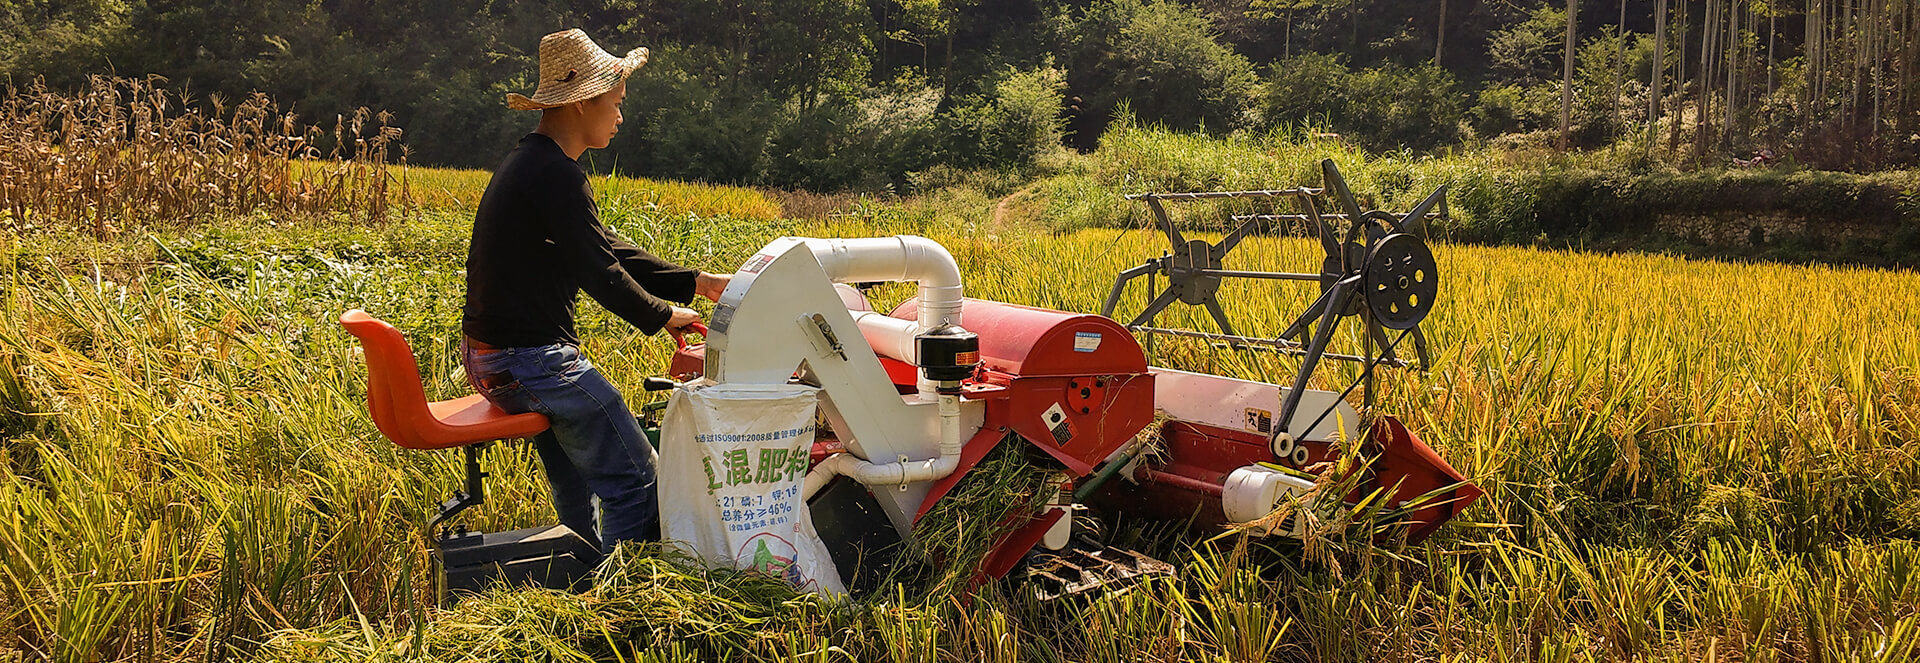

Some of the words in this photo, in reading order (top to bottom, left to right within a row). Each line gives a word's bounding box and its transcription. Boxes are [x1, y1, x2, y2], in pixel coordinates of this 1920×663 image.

[716, 496, 734, 507] :21
[722, 502, 791, 521] 总养分≥46%
